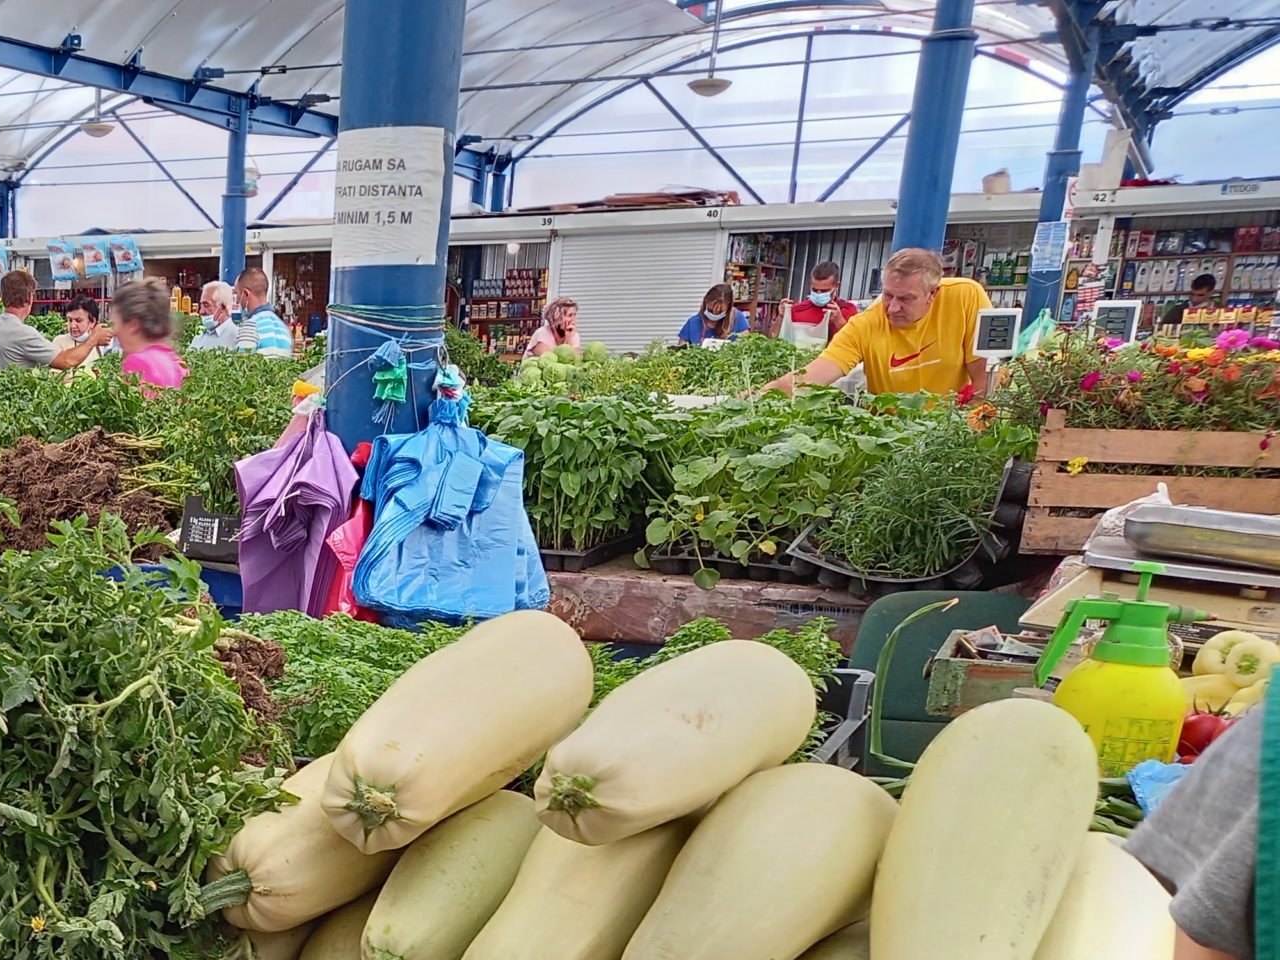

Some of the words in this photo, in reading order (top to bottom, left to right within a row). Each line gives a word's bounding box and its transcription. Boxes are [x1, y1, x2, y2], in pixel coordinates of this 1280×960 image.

[342, 159, 383, 172] RUGAM
[386, 158, 407, 171] SA
[358, 185, 423, 198] DISTANTA
[1093, 193, 1107, 202] 42
[706, 209, 718, 218] 40
[337, 211, 369, 225] MINIM
[374, 211, 396, 226] 1,5
[400, 211, 413, 225] M
[541, 218, 552, 226] 39
[251, 231, 261, 239] 37
[4, 239, 13, 247] 35
